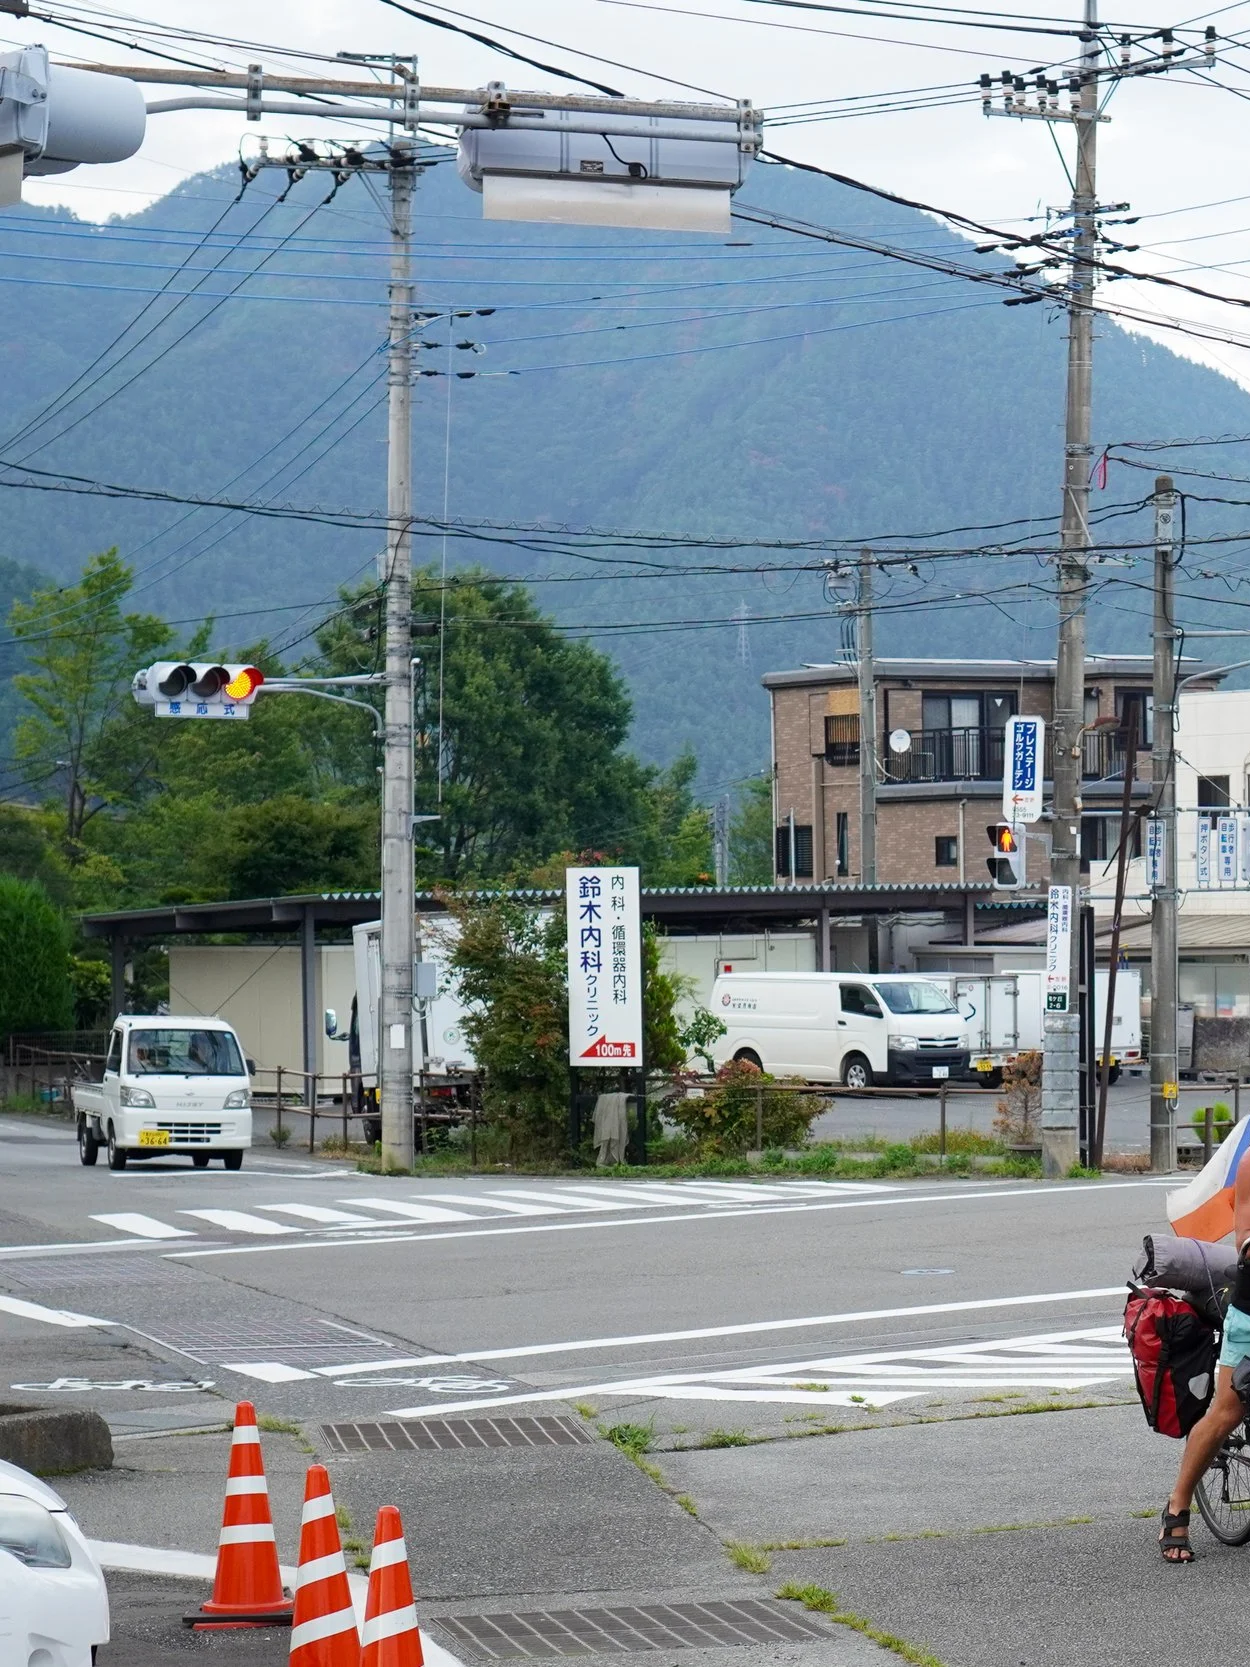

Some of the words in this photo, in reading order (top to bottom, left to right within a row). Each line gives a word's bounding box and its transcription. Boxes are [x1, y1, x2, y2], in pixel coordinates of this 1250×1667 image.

[169, 702, 235, 716] 感応式
[1015, 724, 1025, 788] ゴルフガーデン
[1025, 724, 1036, 788] プレステージ
[1200, 823, 1208, 876] 押ボタン式
[579, 875, 602, 1037] 鈴木内科クリニック
[595, 1043, 632, 1057] 100m先
